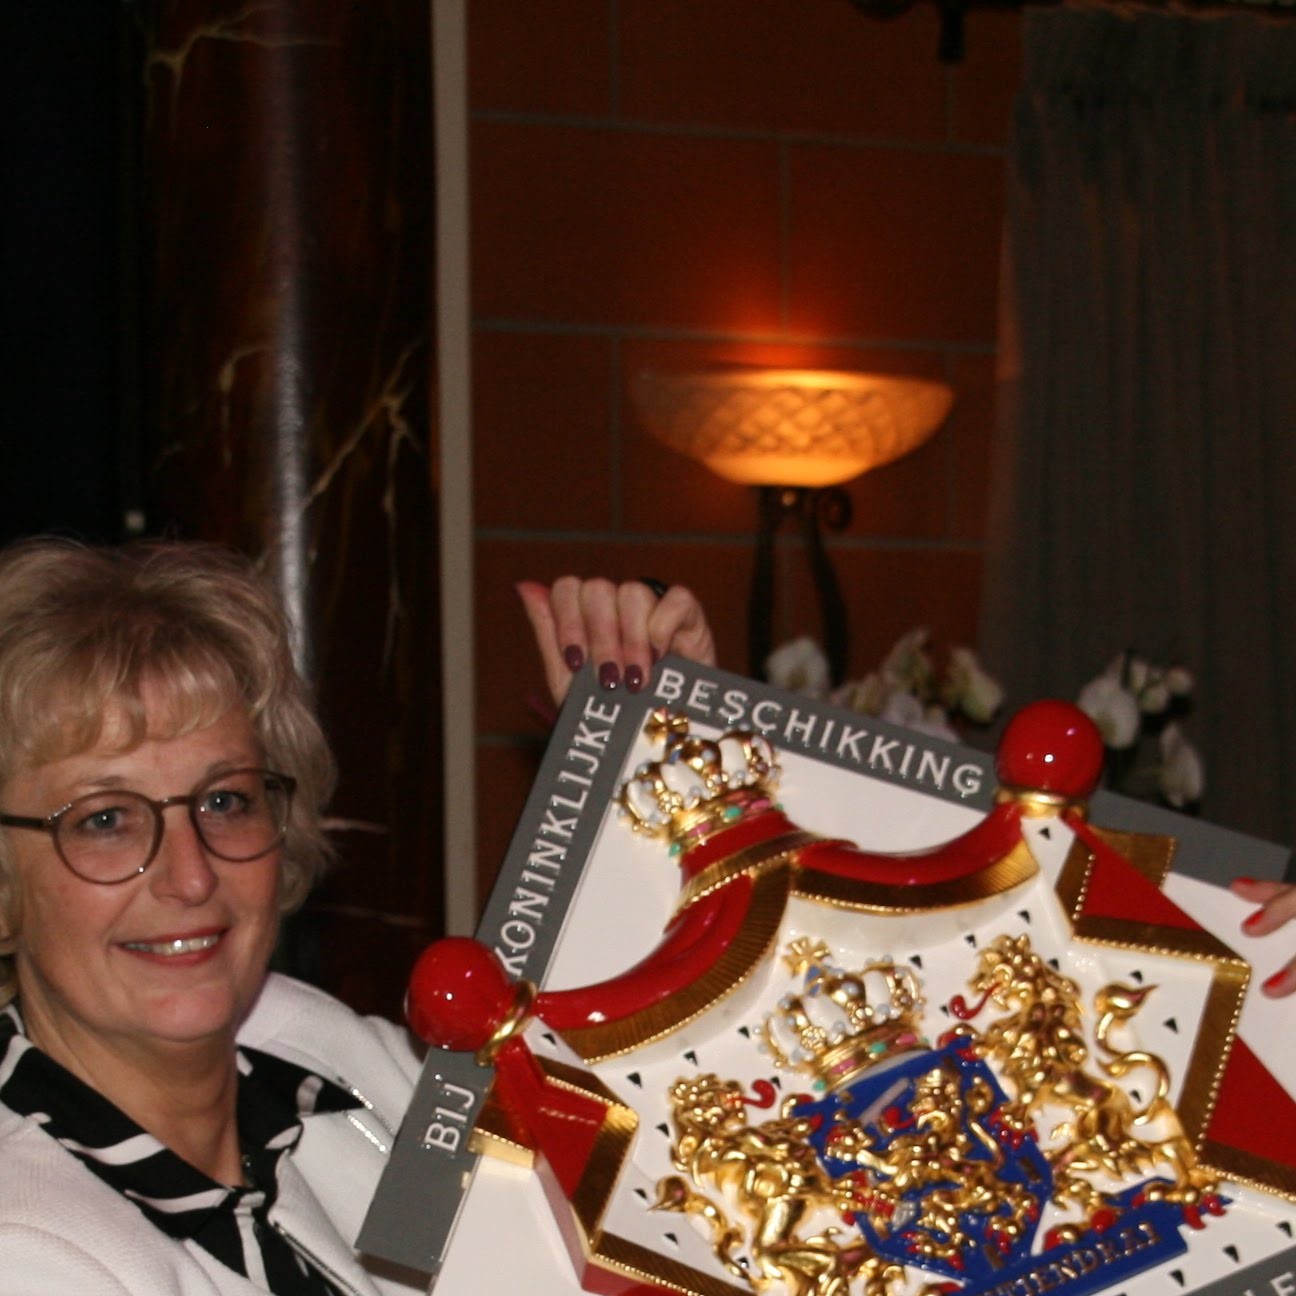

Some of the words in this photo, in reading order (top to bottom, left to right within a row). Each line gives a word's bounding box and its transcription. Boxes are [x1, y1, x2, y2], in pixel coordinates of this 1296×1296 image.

[653, 668, 985, 795] BESCHIKKING
[424, 1083, 475, 1151] BIJ
[494, 696, 621, 976] KONINKLIJKE
